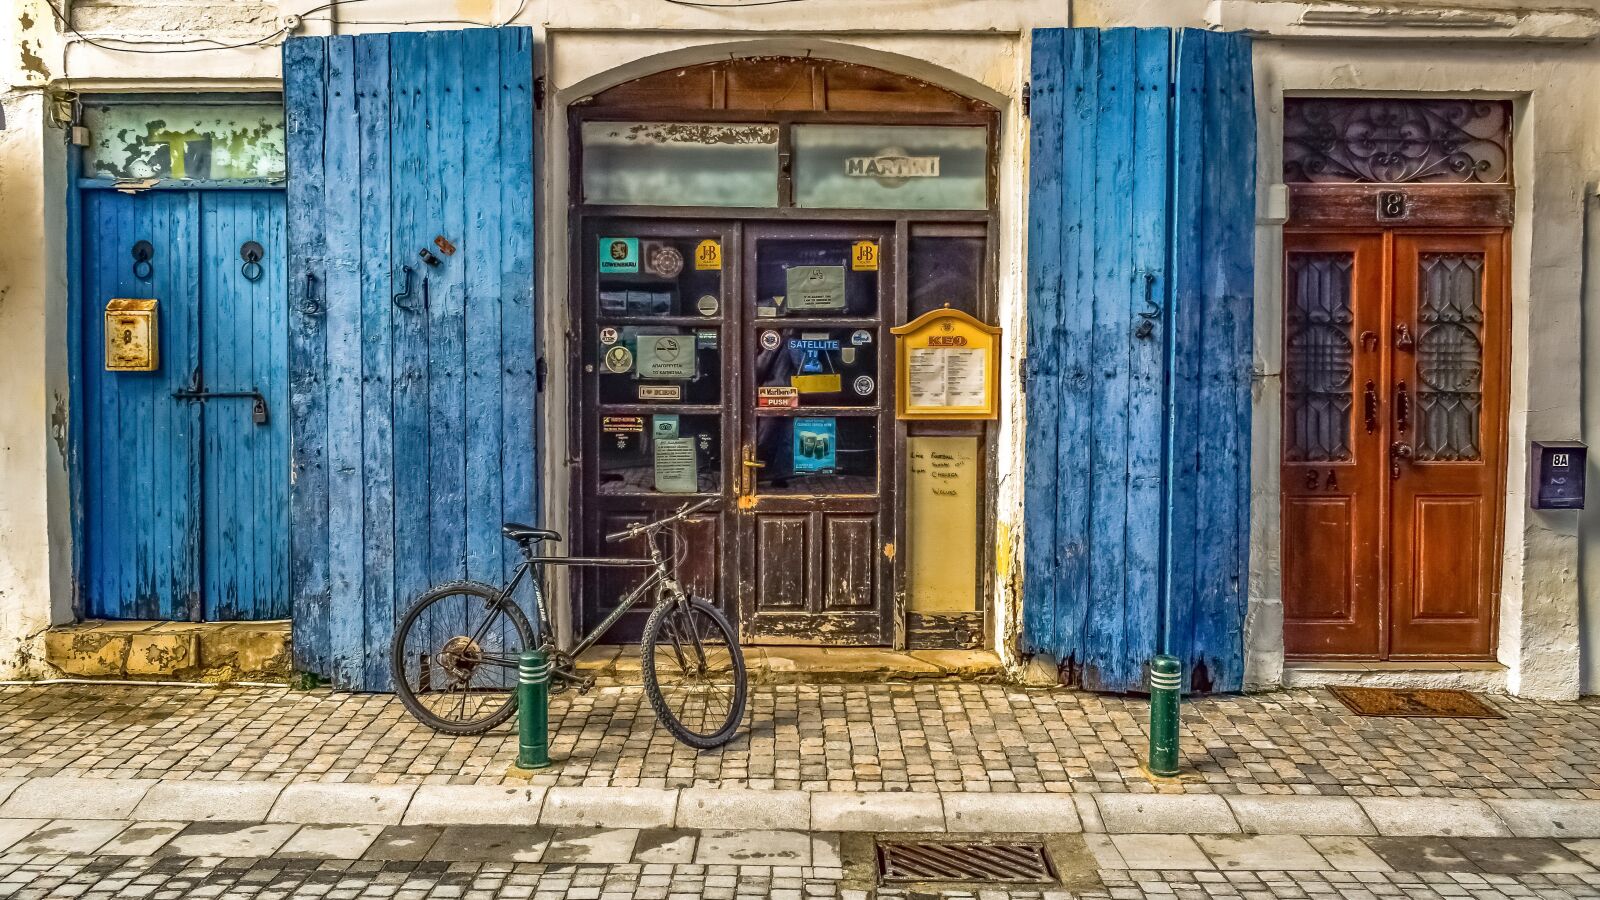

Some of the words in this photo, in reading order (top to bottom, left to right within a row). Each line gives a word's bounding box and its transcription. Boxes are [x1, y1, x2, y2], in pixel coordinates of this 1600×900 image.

[1387, 194, 1401, 215] 8
[700, 246, 716, 260] J&B
[857, 246, 873, 261] J&B
[790, 341, 838, 349] SATELLITE
[928, 336, 967, 346] KEO
[1554, 454, 1567, 466] 8A
